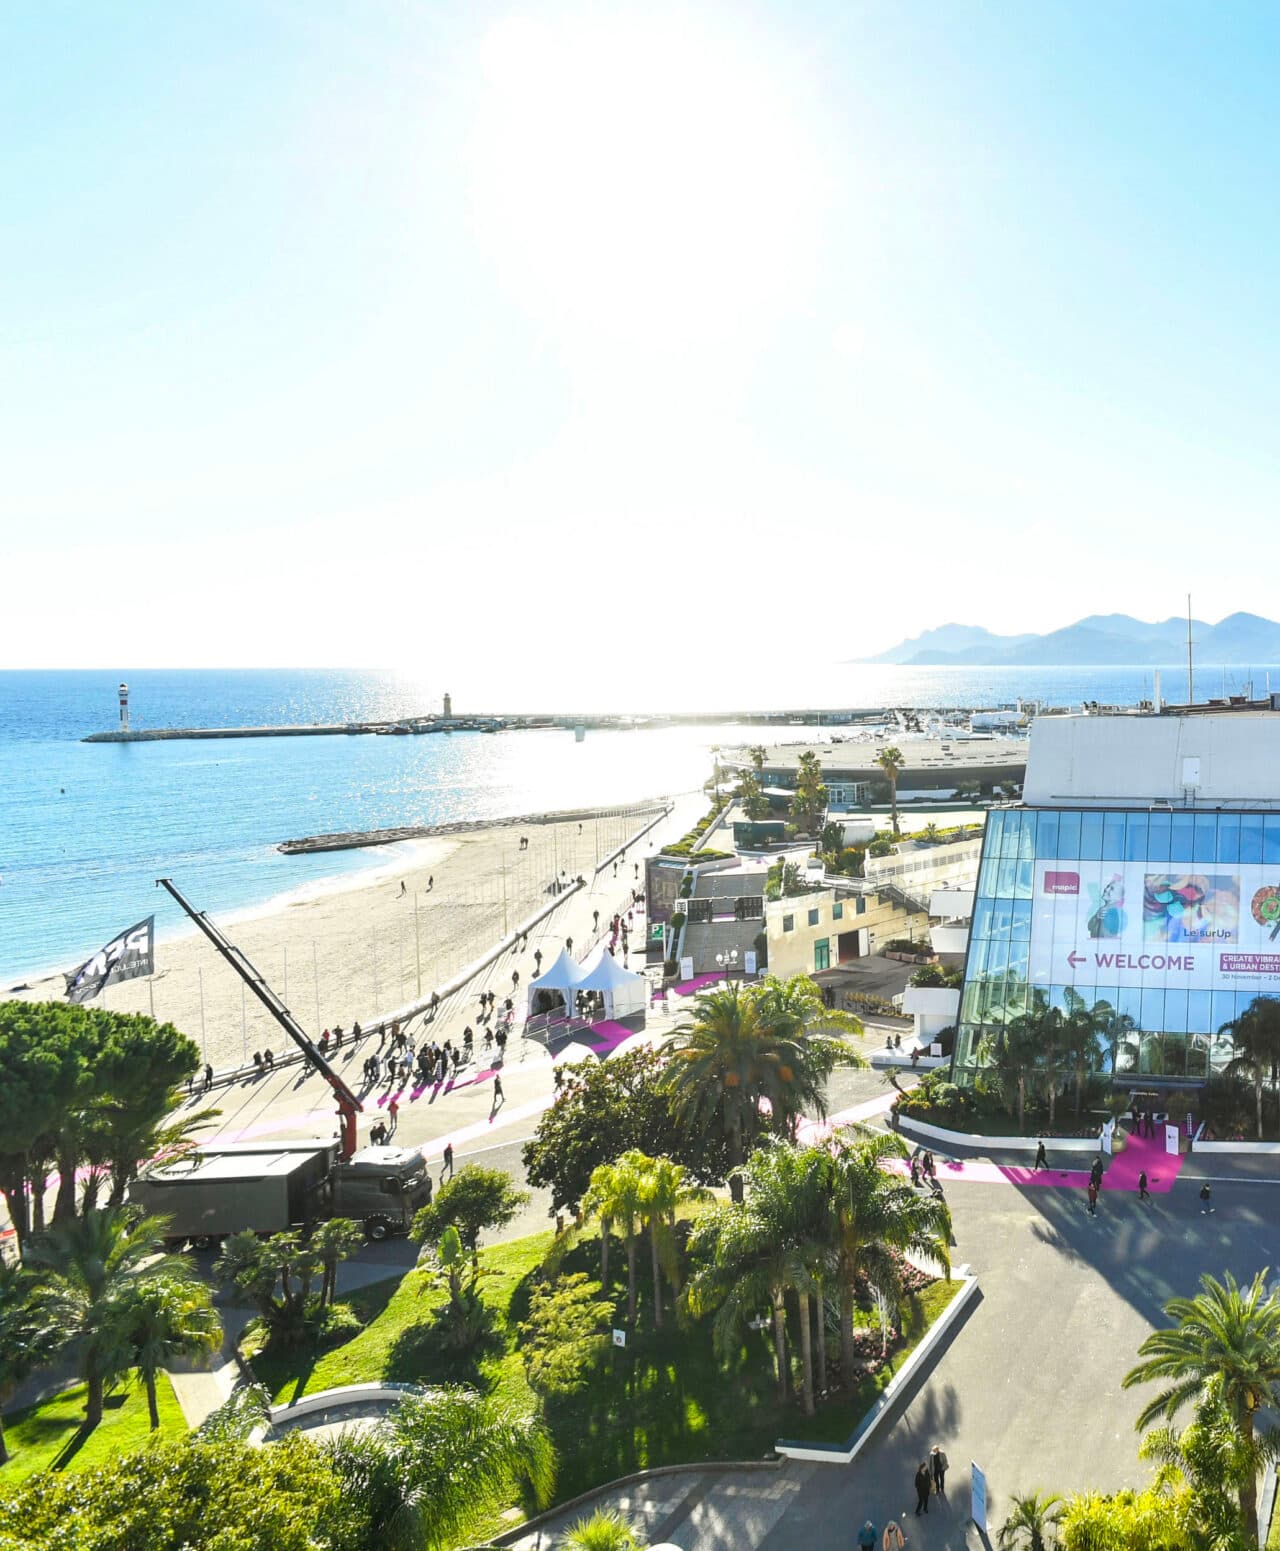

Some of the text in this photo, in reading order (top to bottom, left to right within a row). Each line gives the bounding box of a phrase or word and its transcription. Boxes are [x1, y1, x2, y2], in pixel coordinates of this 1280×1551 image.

[1183, 928, 1231, 939] LeisurUp
[1095, 953, 1195, 971] WELCOME
[1222, 955, 1254, 963] CREATE
[1230, 963, 1258, 971] URBAN
